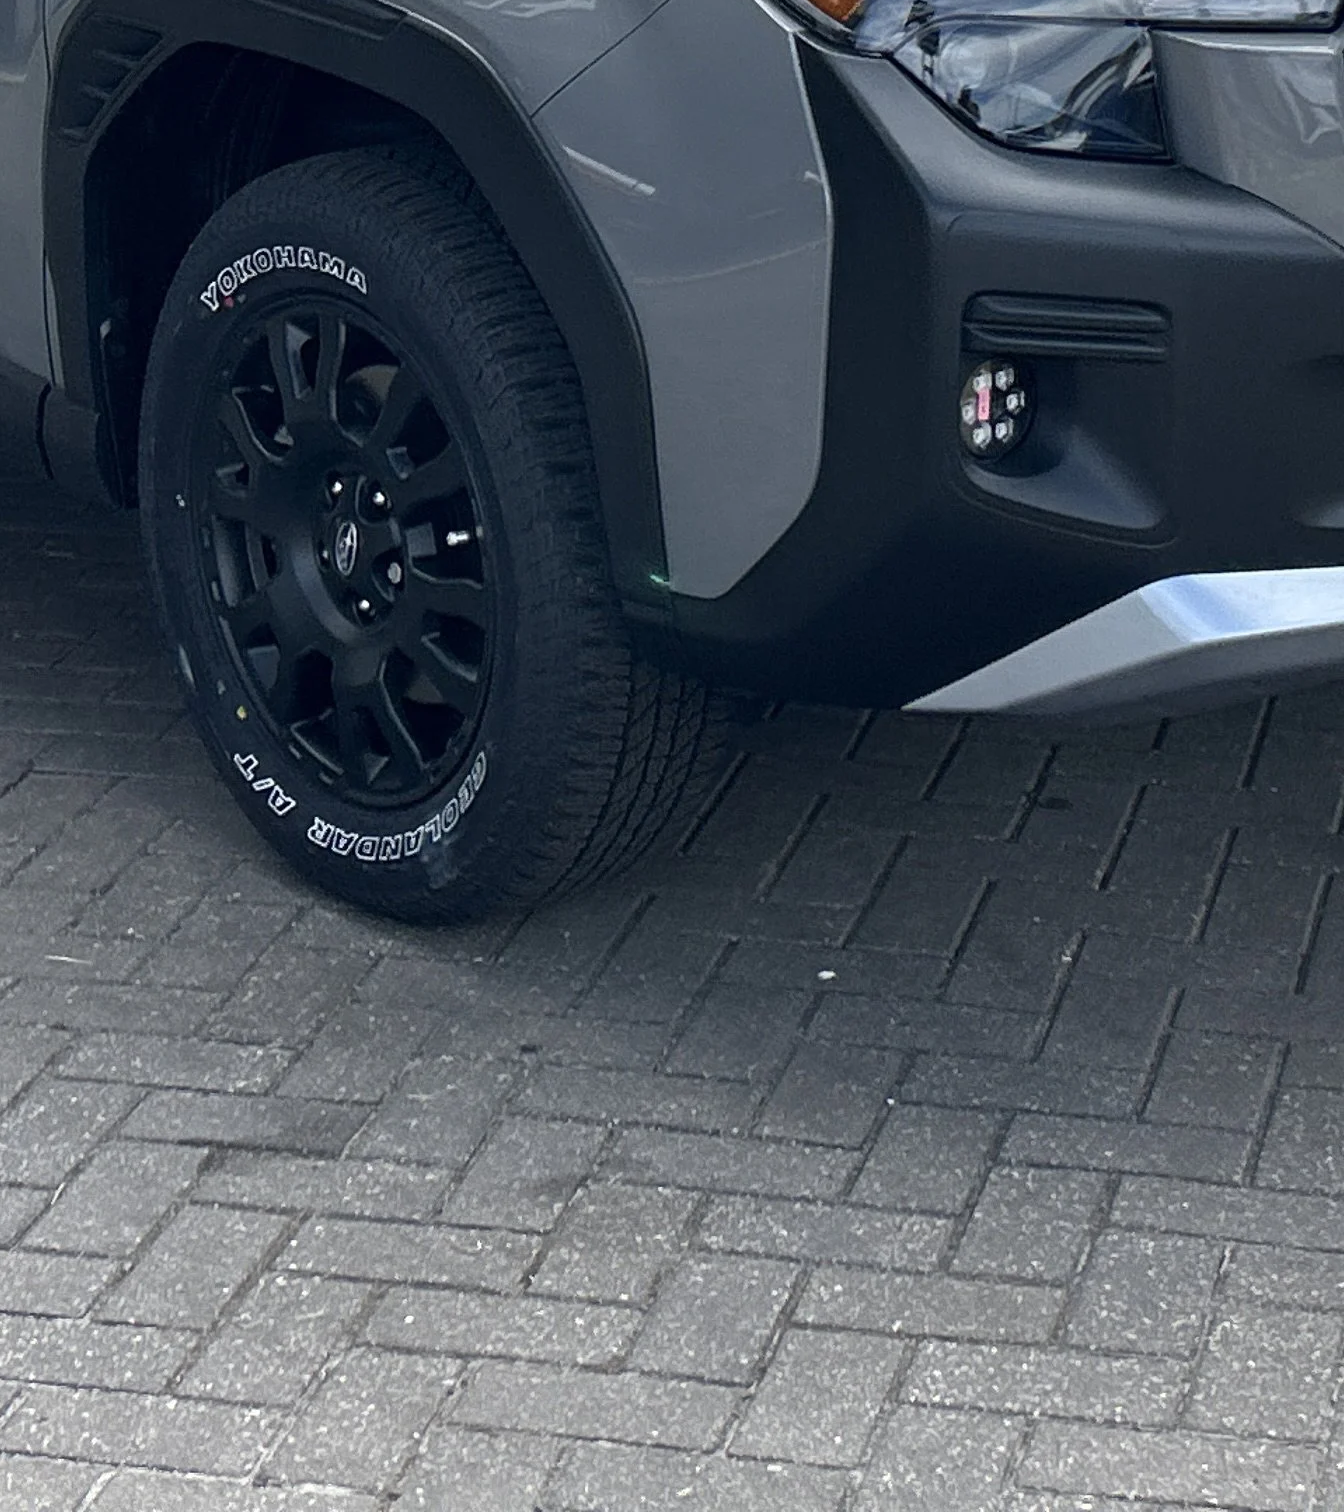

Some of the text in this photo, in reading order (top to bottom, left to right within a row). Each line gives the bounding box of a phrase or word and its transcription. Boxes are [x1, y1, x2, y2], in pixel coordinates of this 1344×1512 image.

[200, 245, 368, 312] YOKOHAMA
[233, 750, 488, 862] GEOLANDAR A/T
